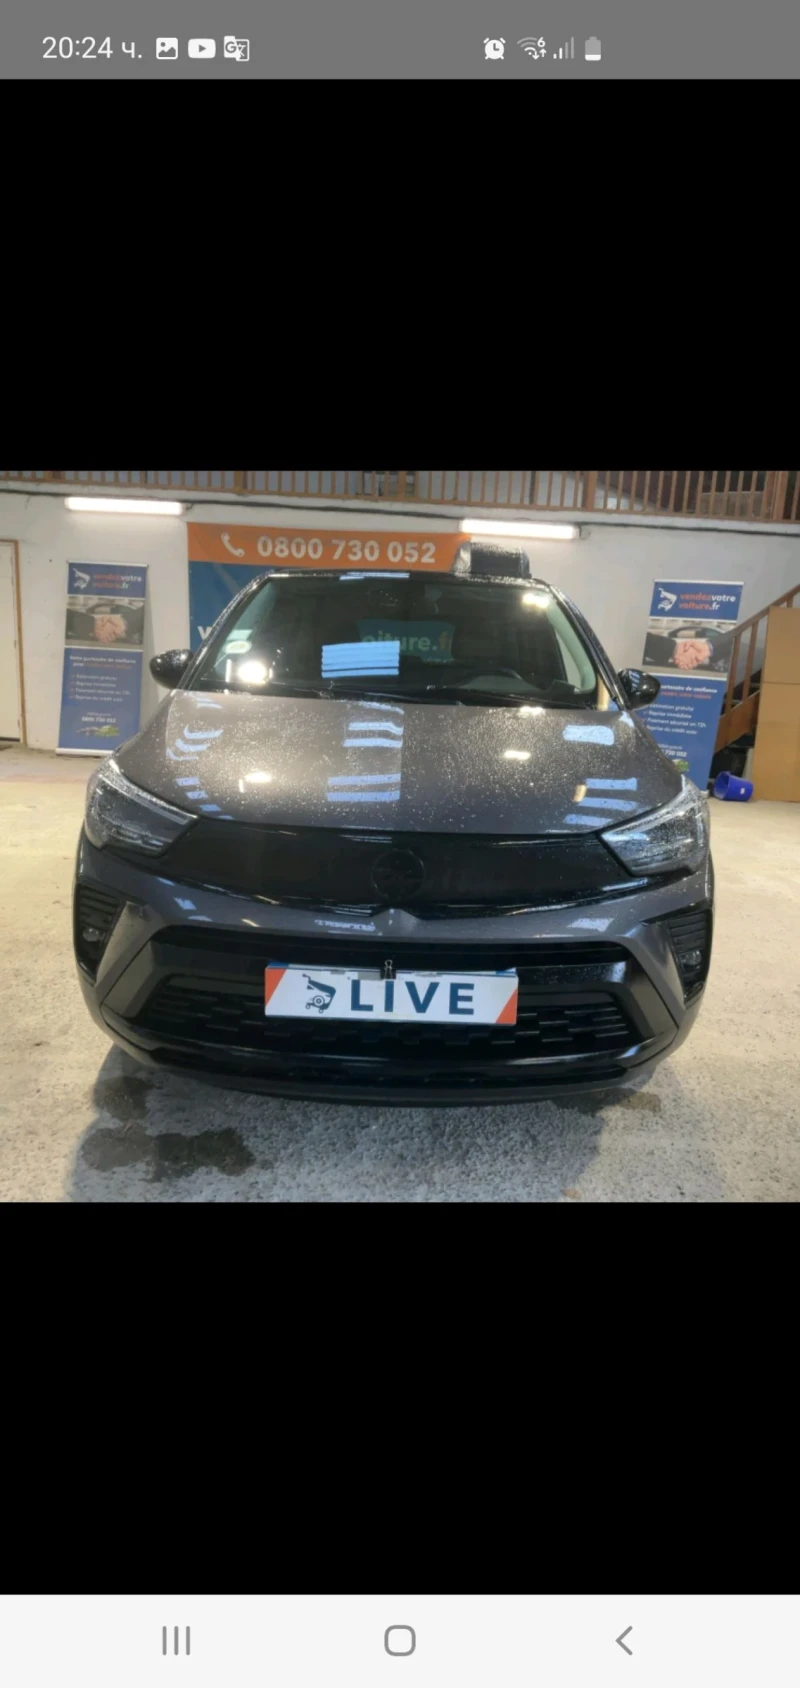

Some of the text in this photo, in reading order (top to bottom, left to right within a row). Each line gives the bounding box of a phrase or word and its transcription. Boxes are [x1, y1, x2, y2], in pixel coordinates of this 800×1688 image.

[257, 535, 436, 564] 0800 730 052
[679, 602, 720, 610] voiture.fr
[351, 979, 475, 1015] LIVE
